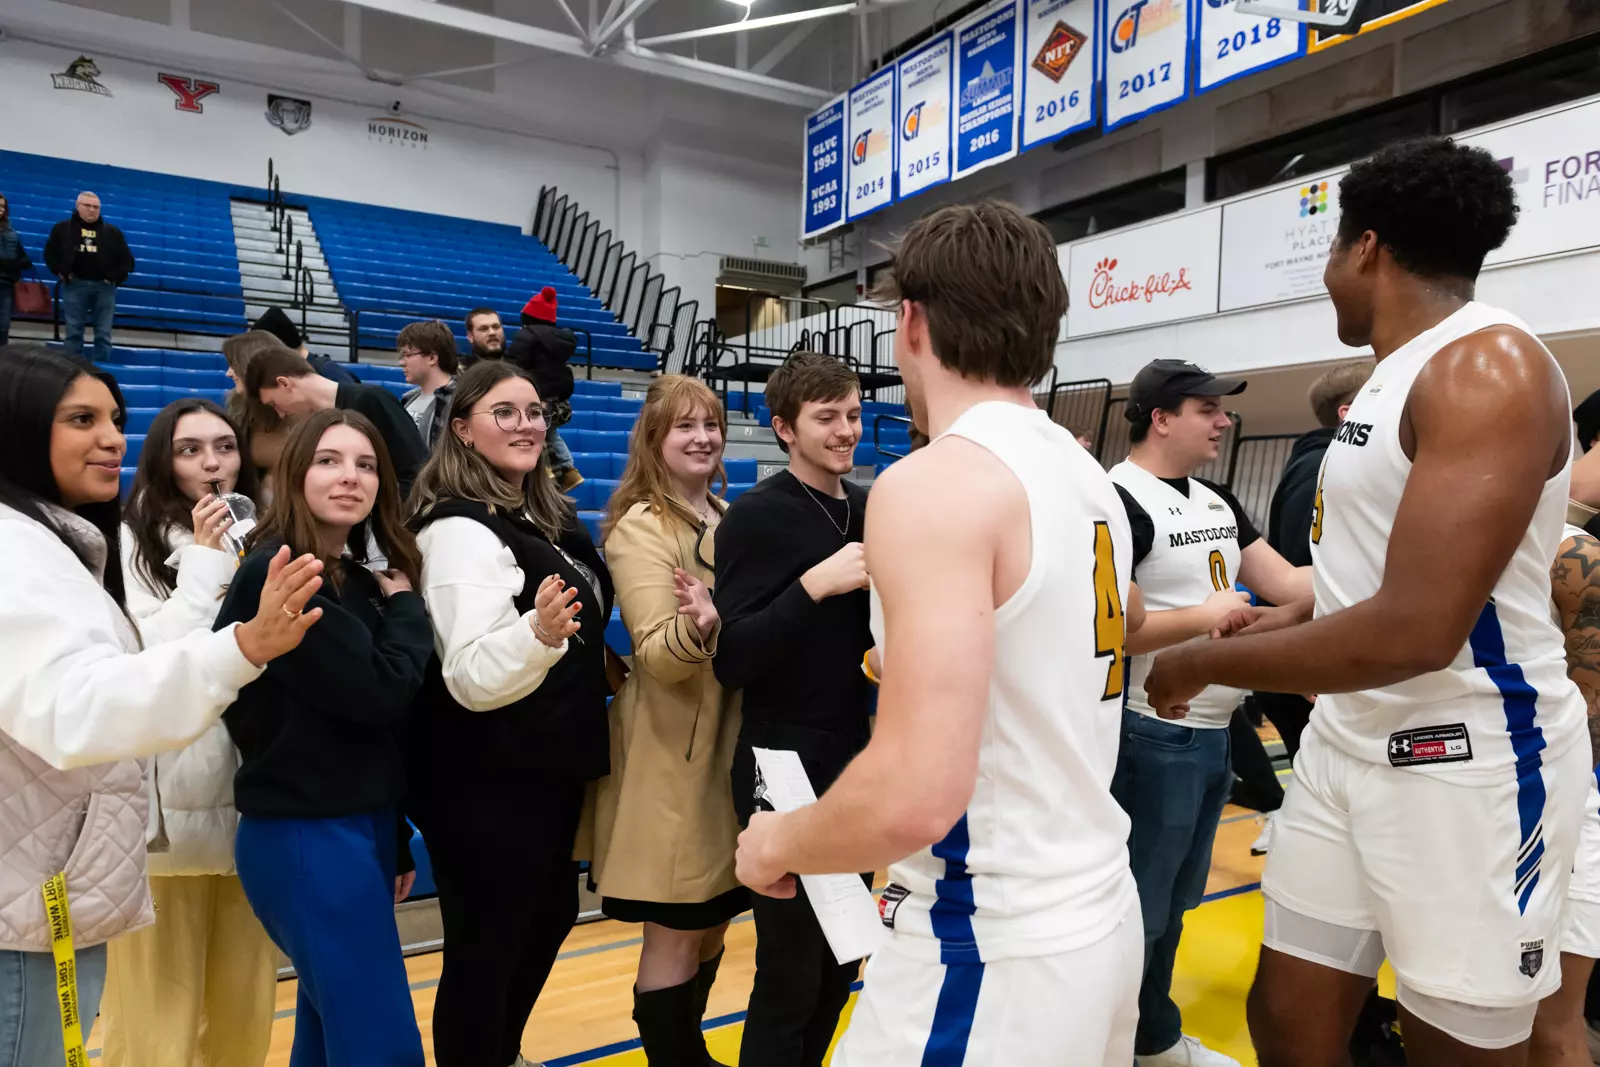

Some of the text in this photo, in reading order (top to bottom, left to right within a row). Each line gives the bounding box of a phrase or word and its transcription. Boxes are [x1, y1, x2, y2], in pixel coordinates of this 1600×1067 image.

[1217, 17, 1281, 59] 2018
[1044, 40, 1075, 65] NIT
[1119, 62, 1171, 99] 2017
[158, 73, 220, 114] Y
[1035, 90, 1079, 122] 2016
[368, 123, 428, 142] HORIZON
[970, 129, 1000, 152] 2016
[812, 135, 837, 157] GLVC
[814, 151, 837, 173] 1993
[908, 151, 940, 177] 2015
[1546, 151, 1600, 184] FOR
[811, 179, 838, 200] NCAA
[856, 176, 884, 200] 2014
[1543, 175, 1600, 208] FINA
[813, 195, 836, 216] 1993
[1169, 526, 1236, 547] MASTODONS
[1093, 520, 1124, 701] 4
[1435, 731, 1462, 739] ARMOUR
[1414, 745, 1444, 754] AUTHENTIC
[50, 904, 63, 942] WAYNE
[58, 961, 73, 1029] FORT WAYNE
